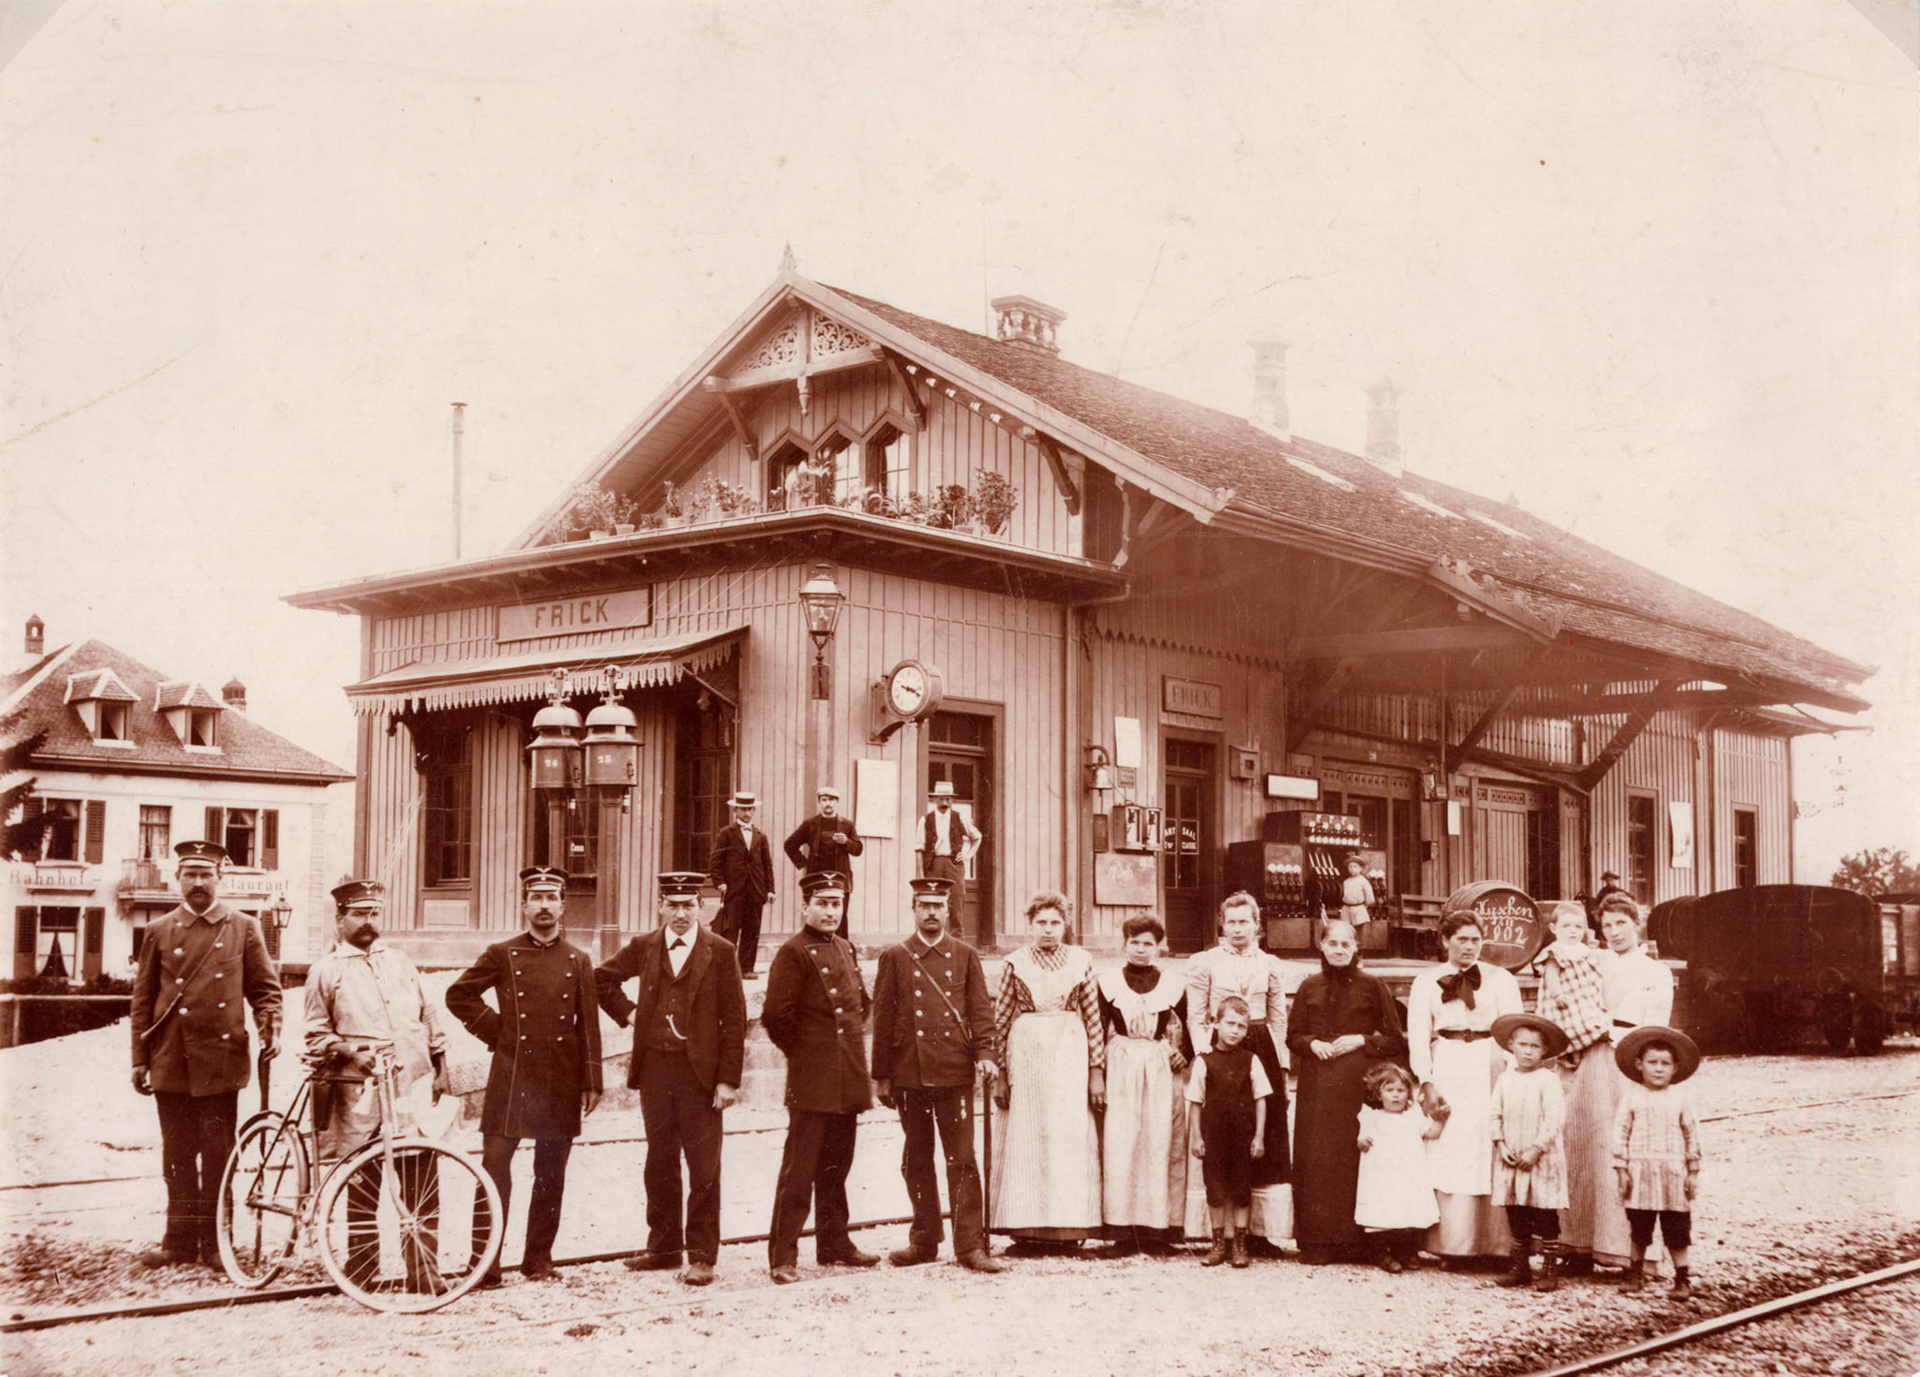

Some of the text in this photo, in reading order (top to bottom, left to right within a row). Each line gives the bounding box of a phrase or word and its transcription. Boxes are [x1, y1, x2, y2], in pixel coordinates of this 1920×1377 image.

[535, 598, 608, 629] FRICK
[221, 878, 290, 892] staurant
[1483, 925, 1529, 945] 1902
